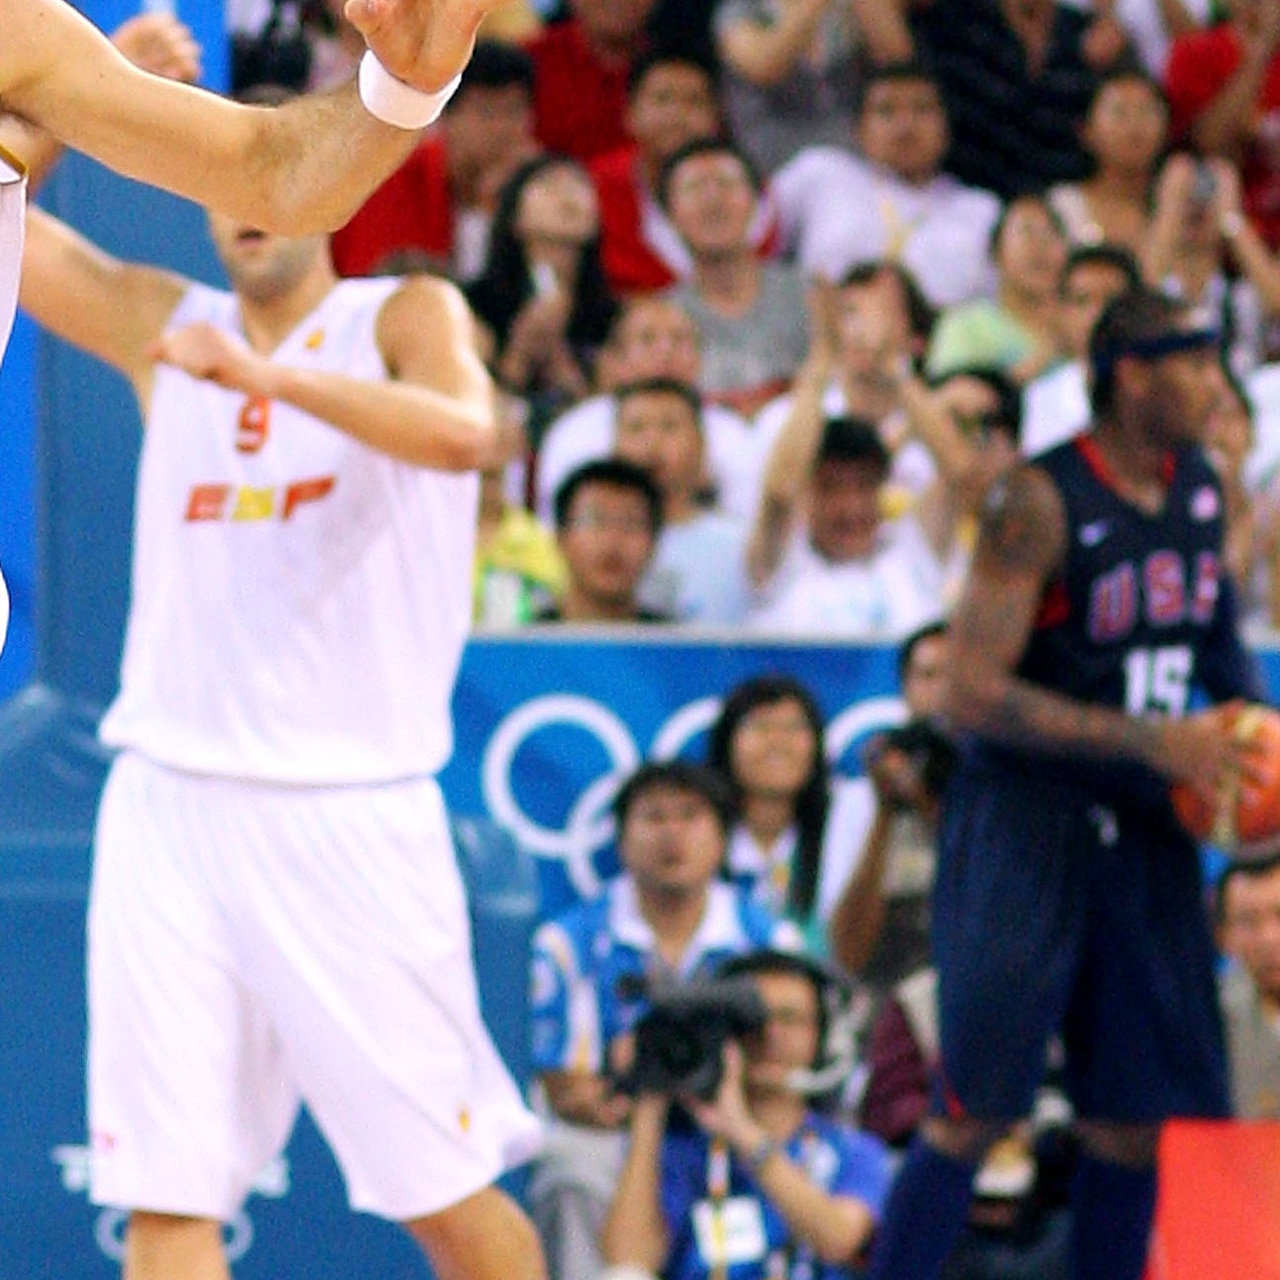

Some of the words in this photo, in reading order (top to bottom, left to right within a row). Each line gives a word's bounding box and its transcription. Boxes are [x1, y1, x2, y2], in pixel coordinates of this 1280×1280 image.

[235, 390, 273, 456] 9
[183, 474, 338, 524] ESP
[1123, 644, 1193, 723] 15
